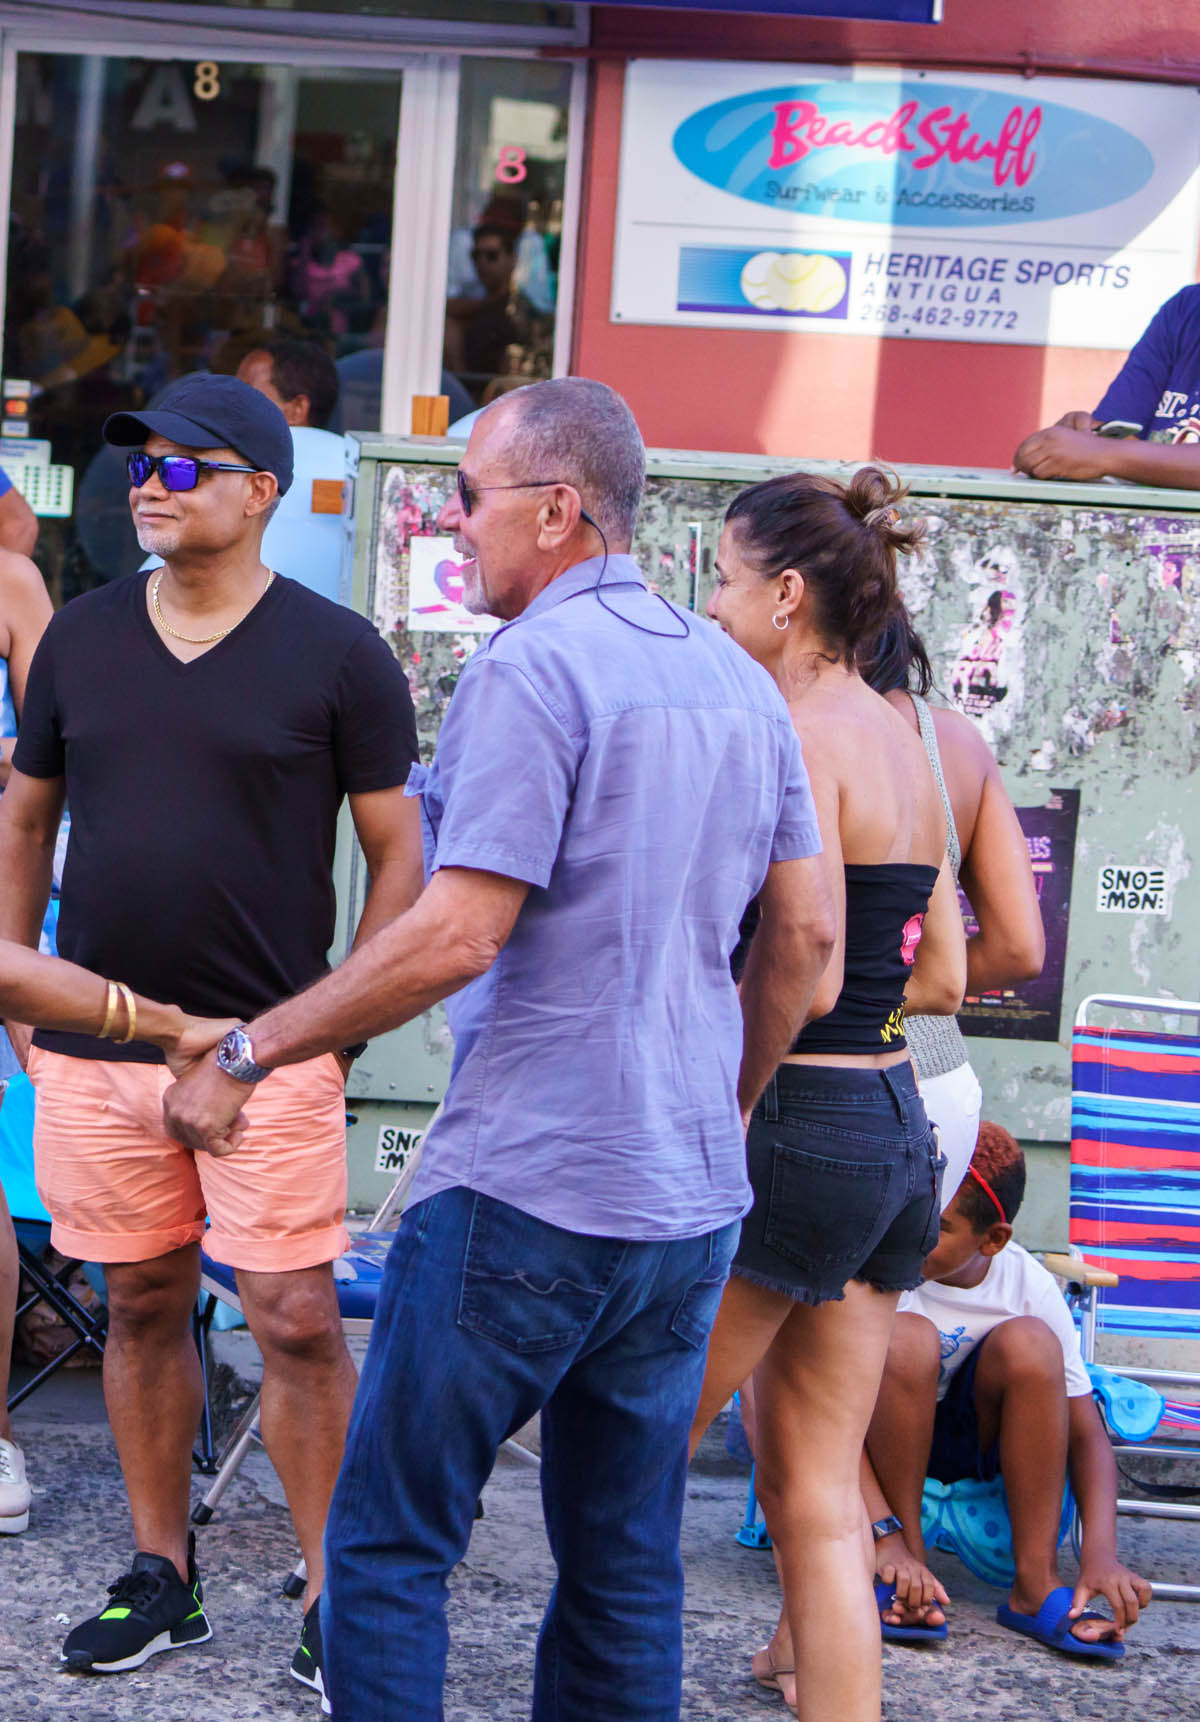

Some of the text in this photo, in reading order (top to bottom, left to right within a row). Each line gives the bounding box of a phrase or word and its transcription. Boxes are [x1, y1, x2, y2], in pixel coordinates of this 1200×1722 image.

[193, 61, 220, 100] 8
[495, 145, 527, 184] 8
[765, 180, 868, 204] Surfwear
[896, 188, 1036, 213] Accessories
[864, 252, 1131, 289] HERITAGE SPORTS
[861, 281, 1001, 305] ANTIGUA
[860, 304, 1018, 329] 268-462-9772
